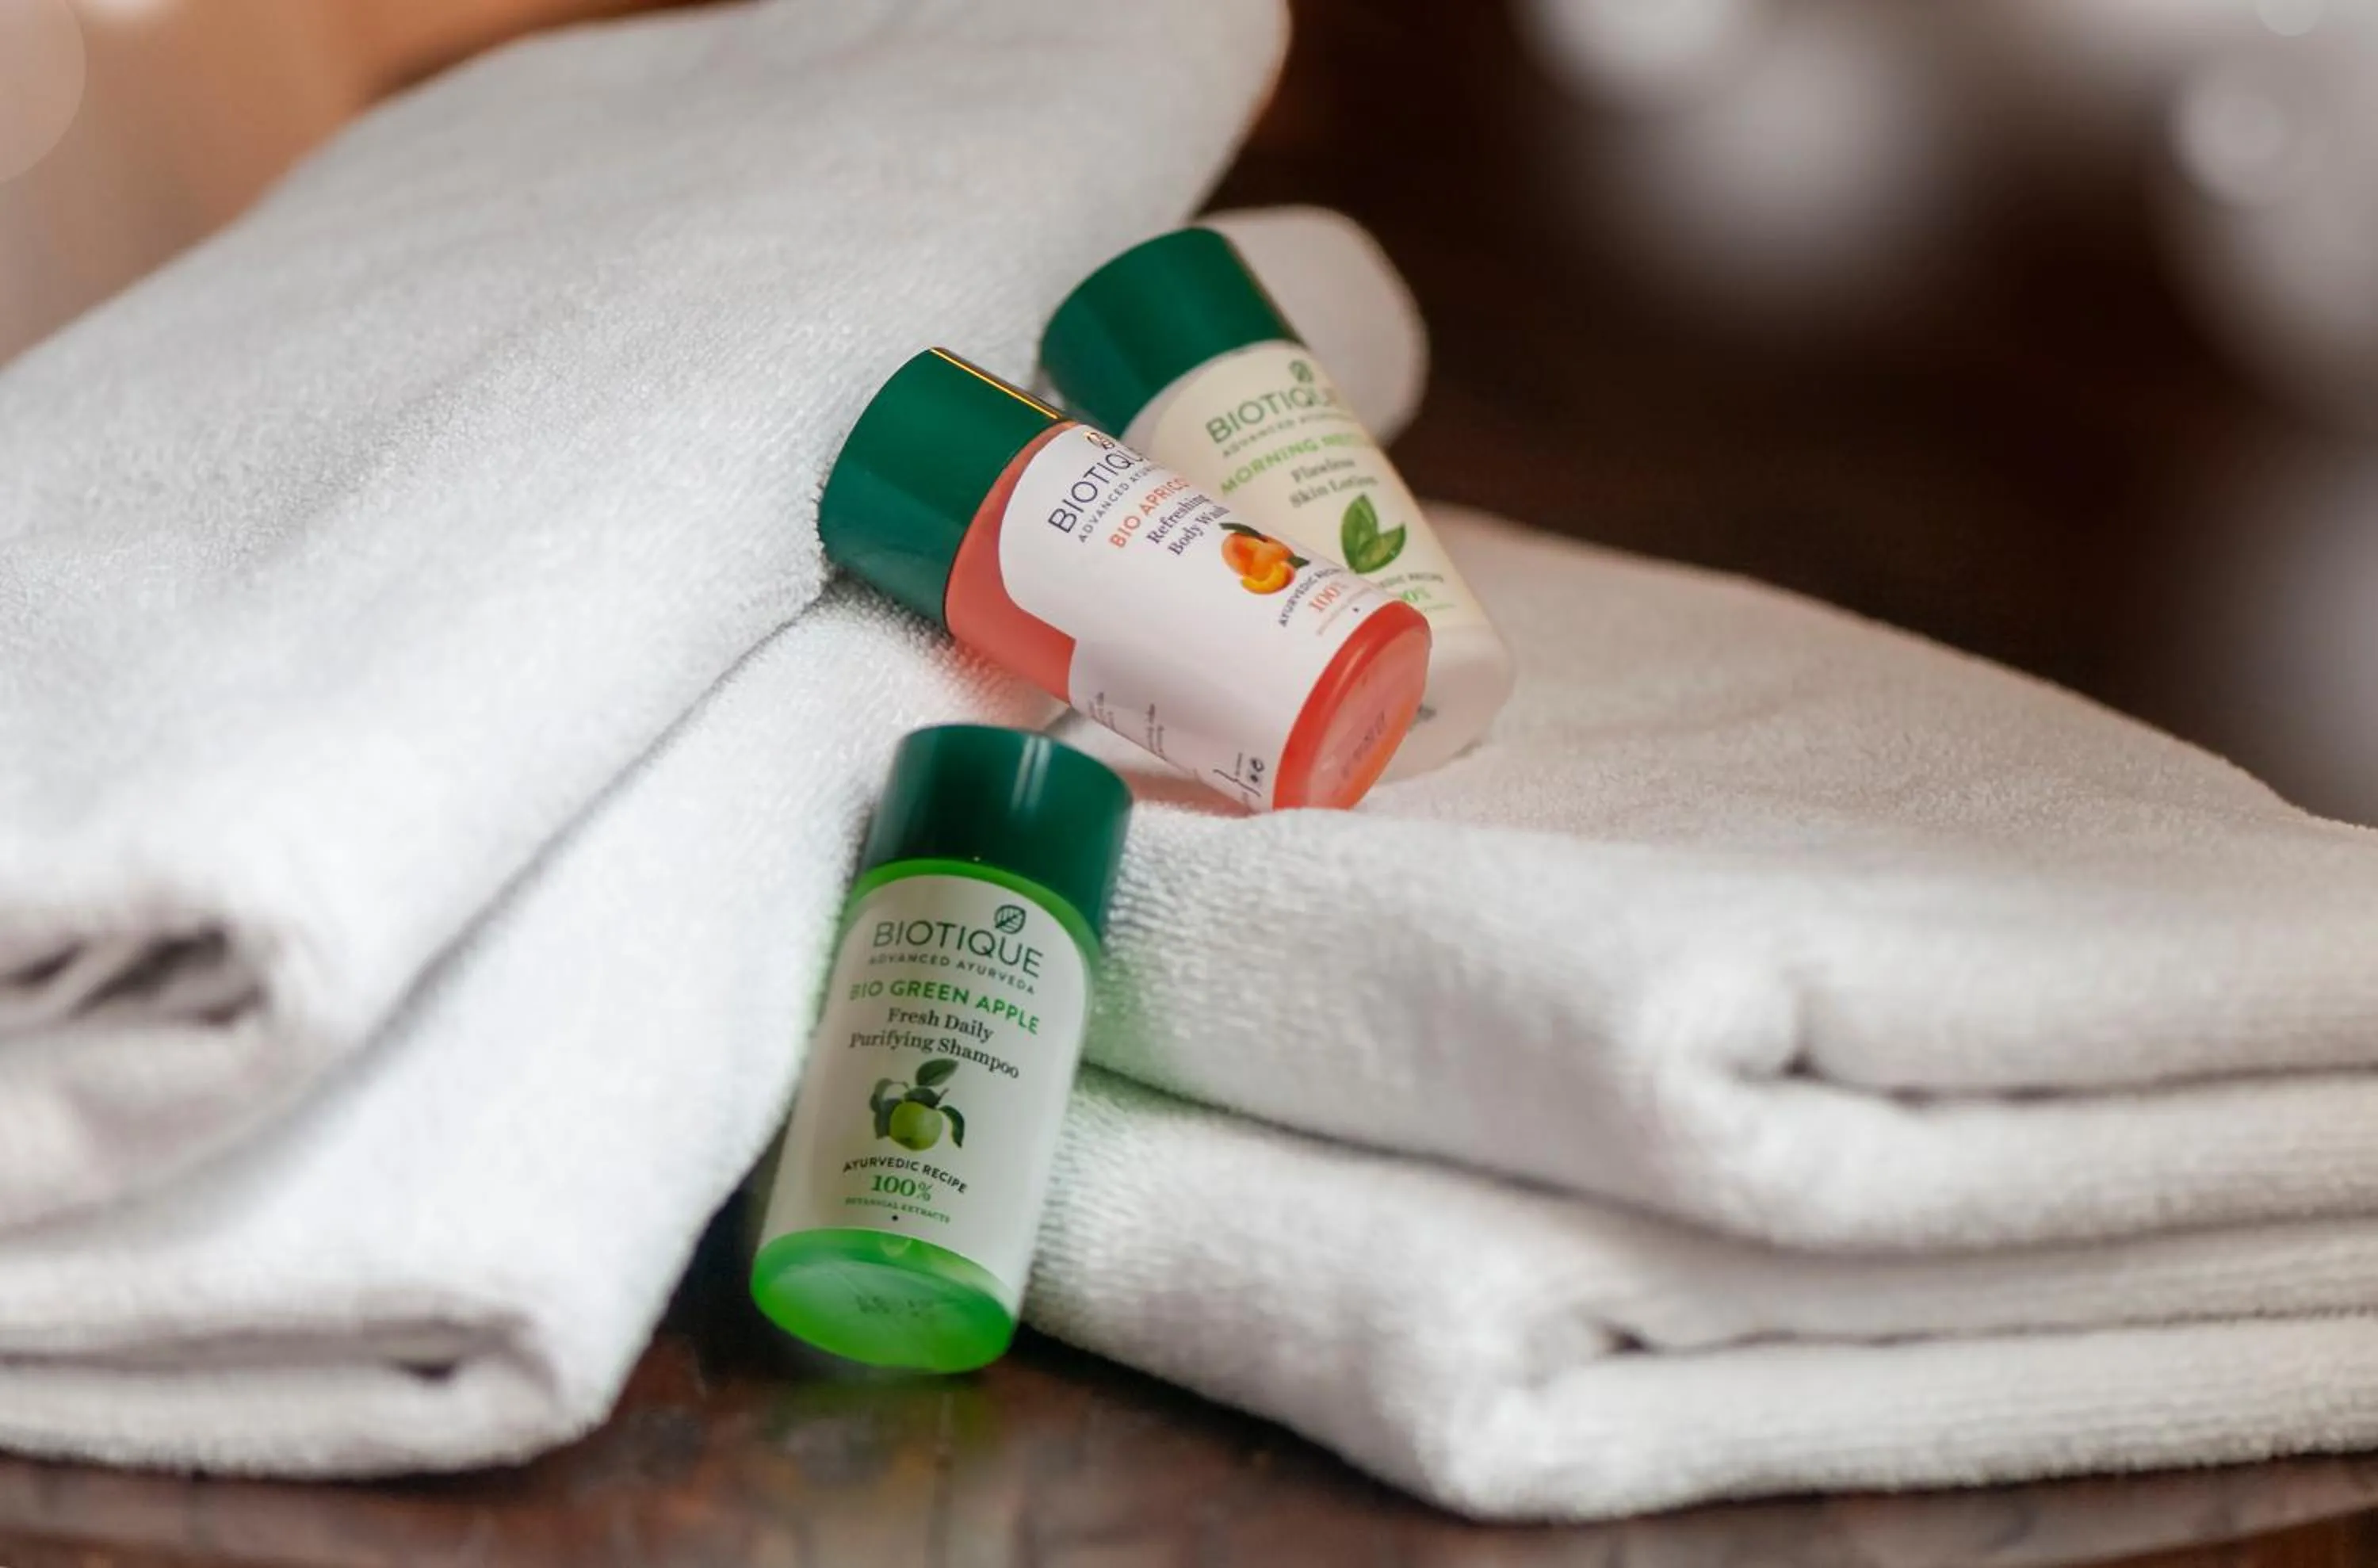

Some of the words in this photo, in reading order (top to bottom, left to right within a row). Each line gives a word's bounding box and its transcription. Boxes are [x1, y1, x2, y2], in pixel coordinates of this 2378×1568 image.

[1206, 386, 1337, 444] BIOTIQU
[1048, 445, 1149, 534] BIOTIQU
[1078, 483, 1130, 543] ADVANCED
[1110, 514, 1141, 549] BIO
[1139, 477, 1191, 516] APRICO
[1168, 523, 1205, 556] Body
[869, 952, 950, 966] ADVANCED
[956, 959, 1035, 994] AYURVEDA
[873, 920, 1044, 978] BIOTIQUE
[849, 980, 884, 1001] BIO
[889, 979, 970, 1005] GREEN
[975, 995, 1040, 1035] APPLE
[887, 1006, 940, 1027] Fresh
[944, 1013, 995, 1043] Daily
[849, 1030, 935, 1054] Purifying
[937, 1037, 1020, 1080] Shampoo
[842, 1156, 919, 1173] AYURVEDIC
[922, 1164, 968, 1195] RECIPE
[870, 1174, 932, 1202] 100%
